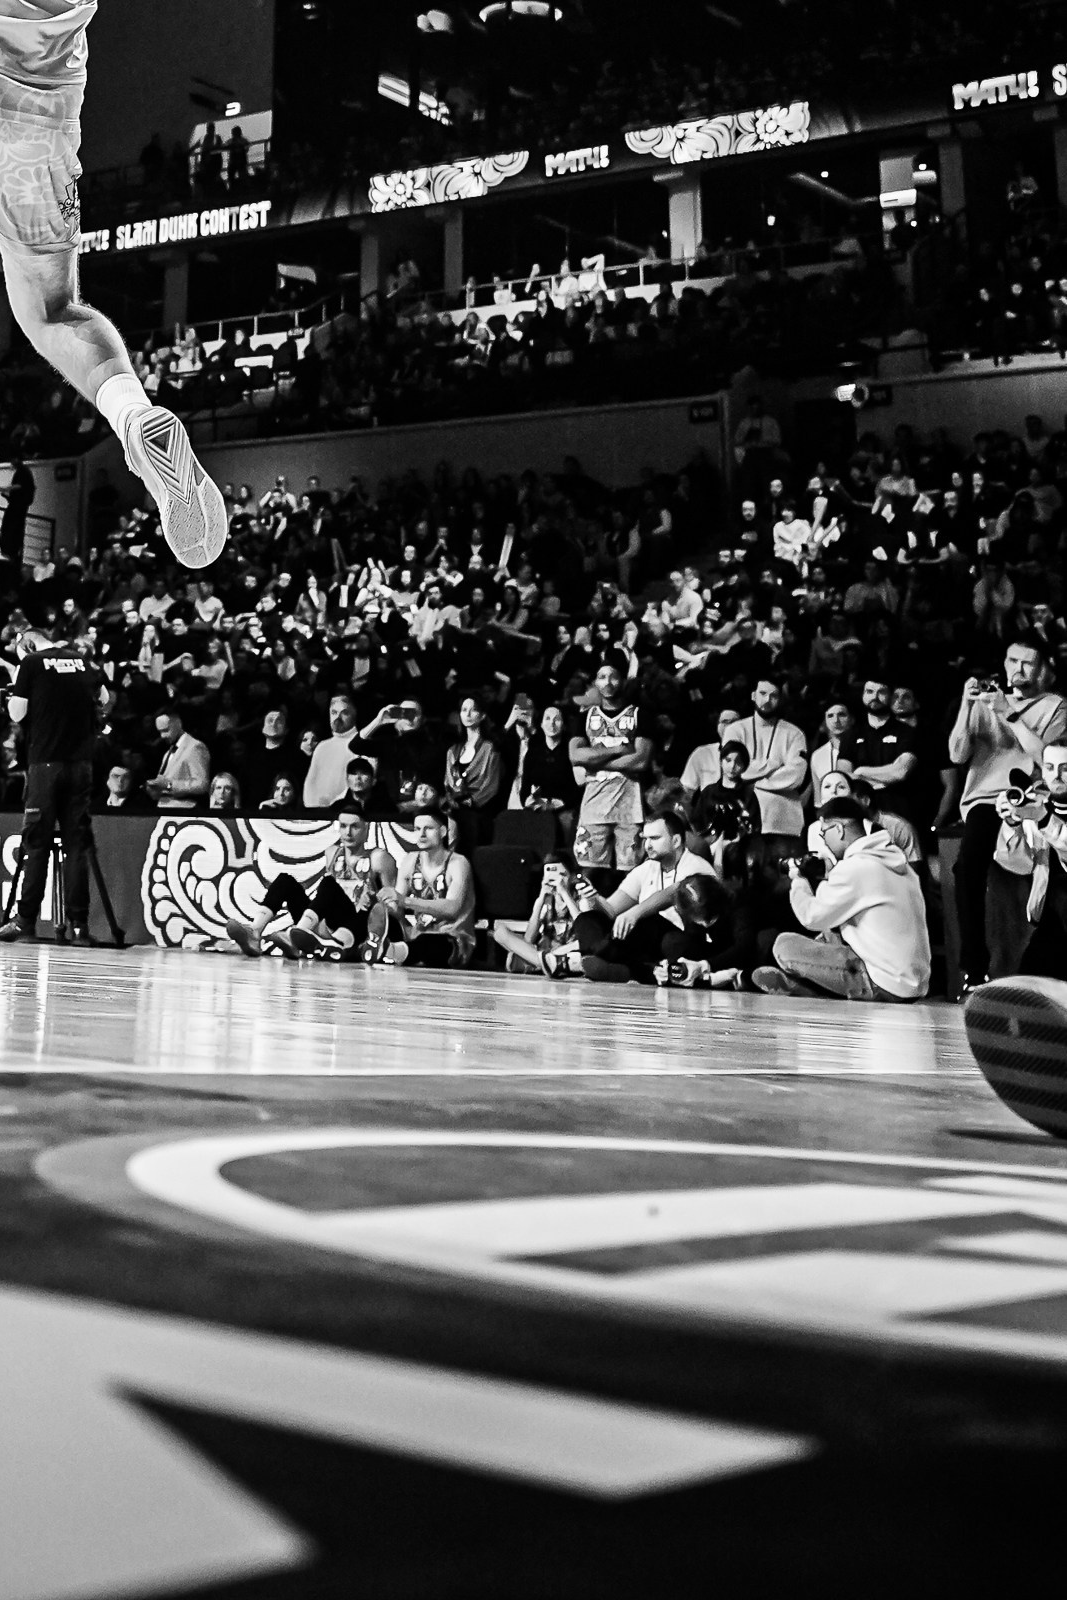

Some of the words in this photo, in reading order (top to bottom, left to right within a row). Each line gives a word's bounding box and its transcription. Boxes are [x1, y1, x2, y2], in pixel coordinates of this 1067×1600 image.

[116, 219, 158, 250] SLAM
[159, 213, 199, 243] DUNK
[199, 201, 271, 237] CONTEST
